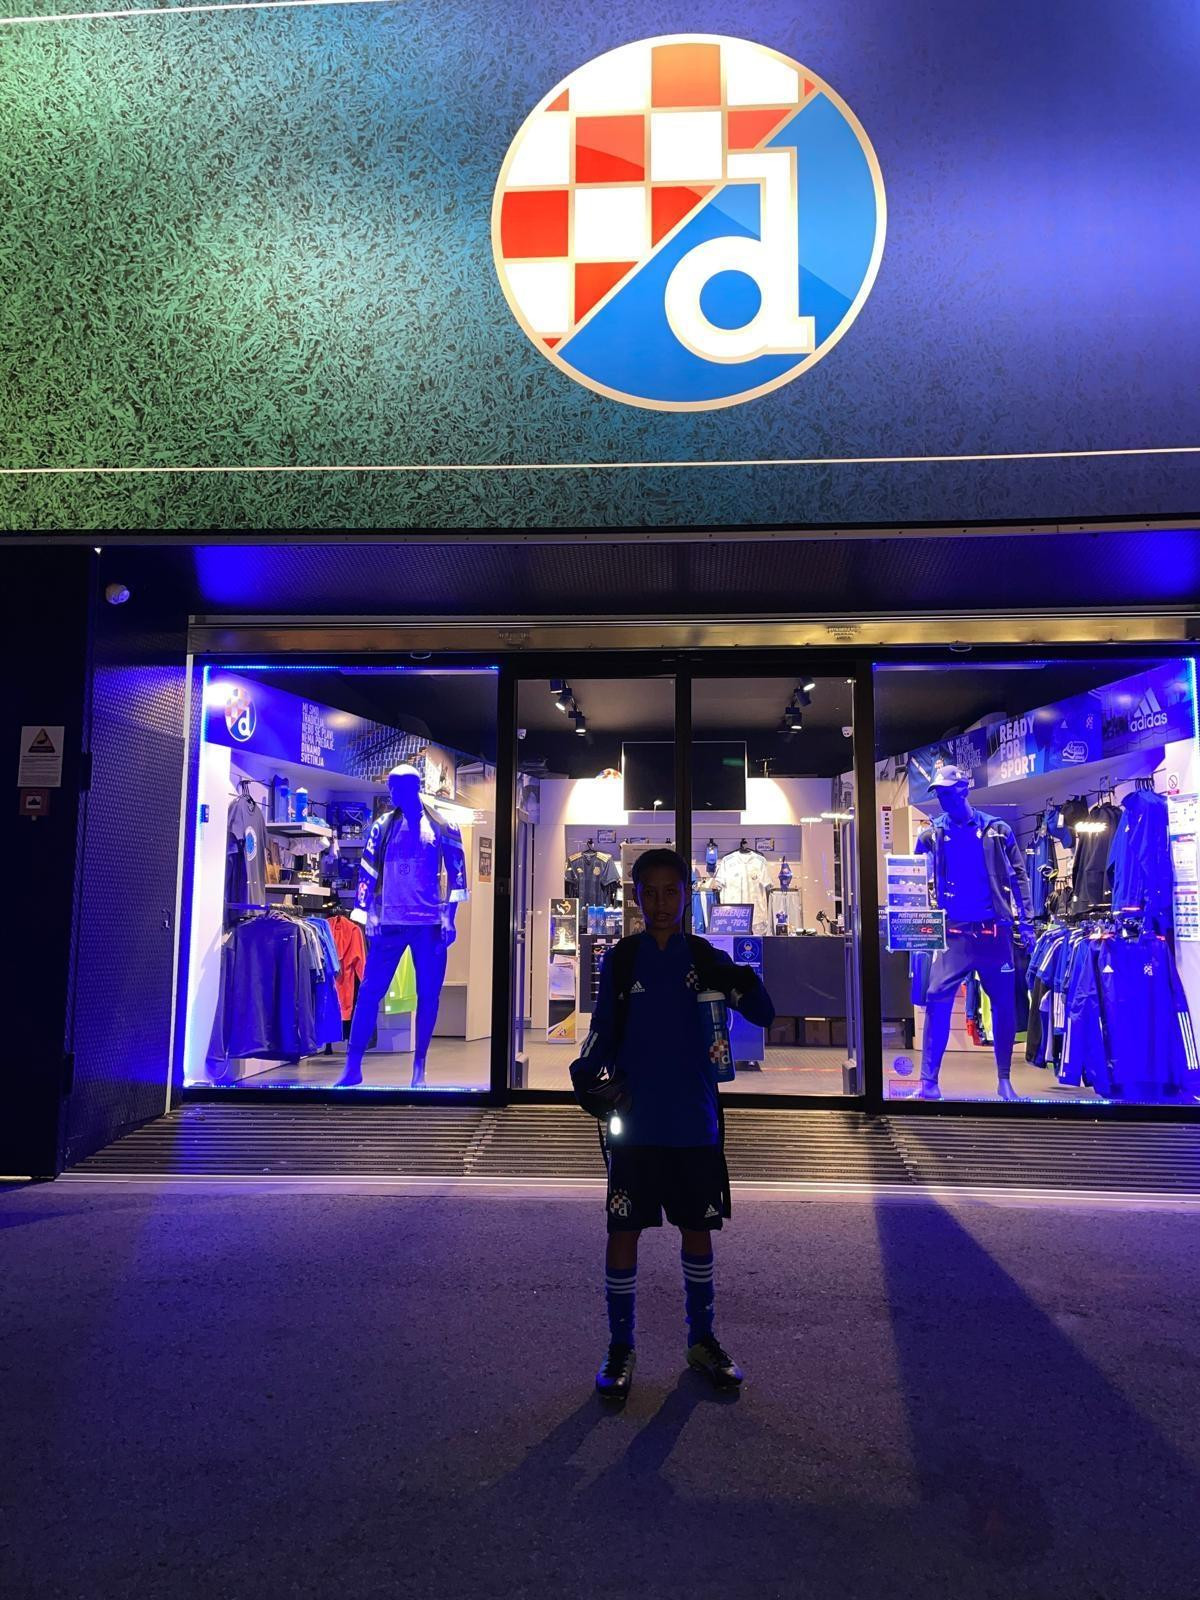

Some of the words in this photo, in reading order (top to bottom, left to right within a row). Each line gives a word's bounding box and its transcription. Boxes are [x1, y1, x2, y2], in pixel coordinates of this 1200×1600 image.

[1000, 715, 1035, 743] READY
[1130, 712, 1168, 732] adidas
[1000, 740, 1020, 762] FOR
[1000, 753, 1036, 779] SPORT
